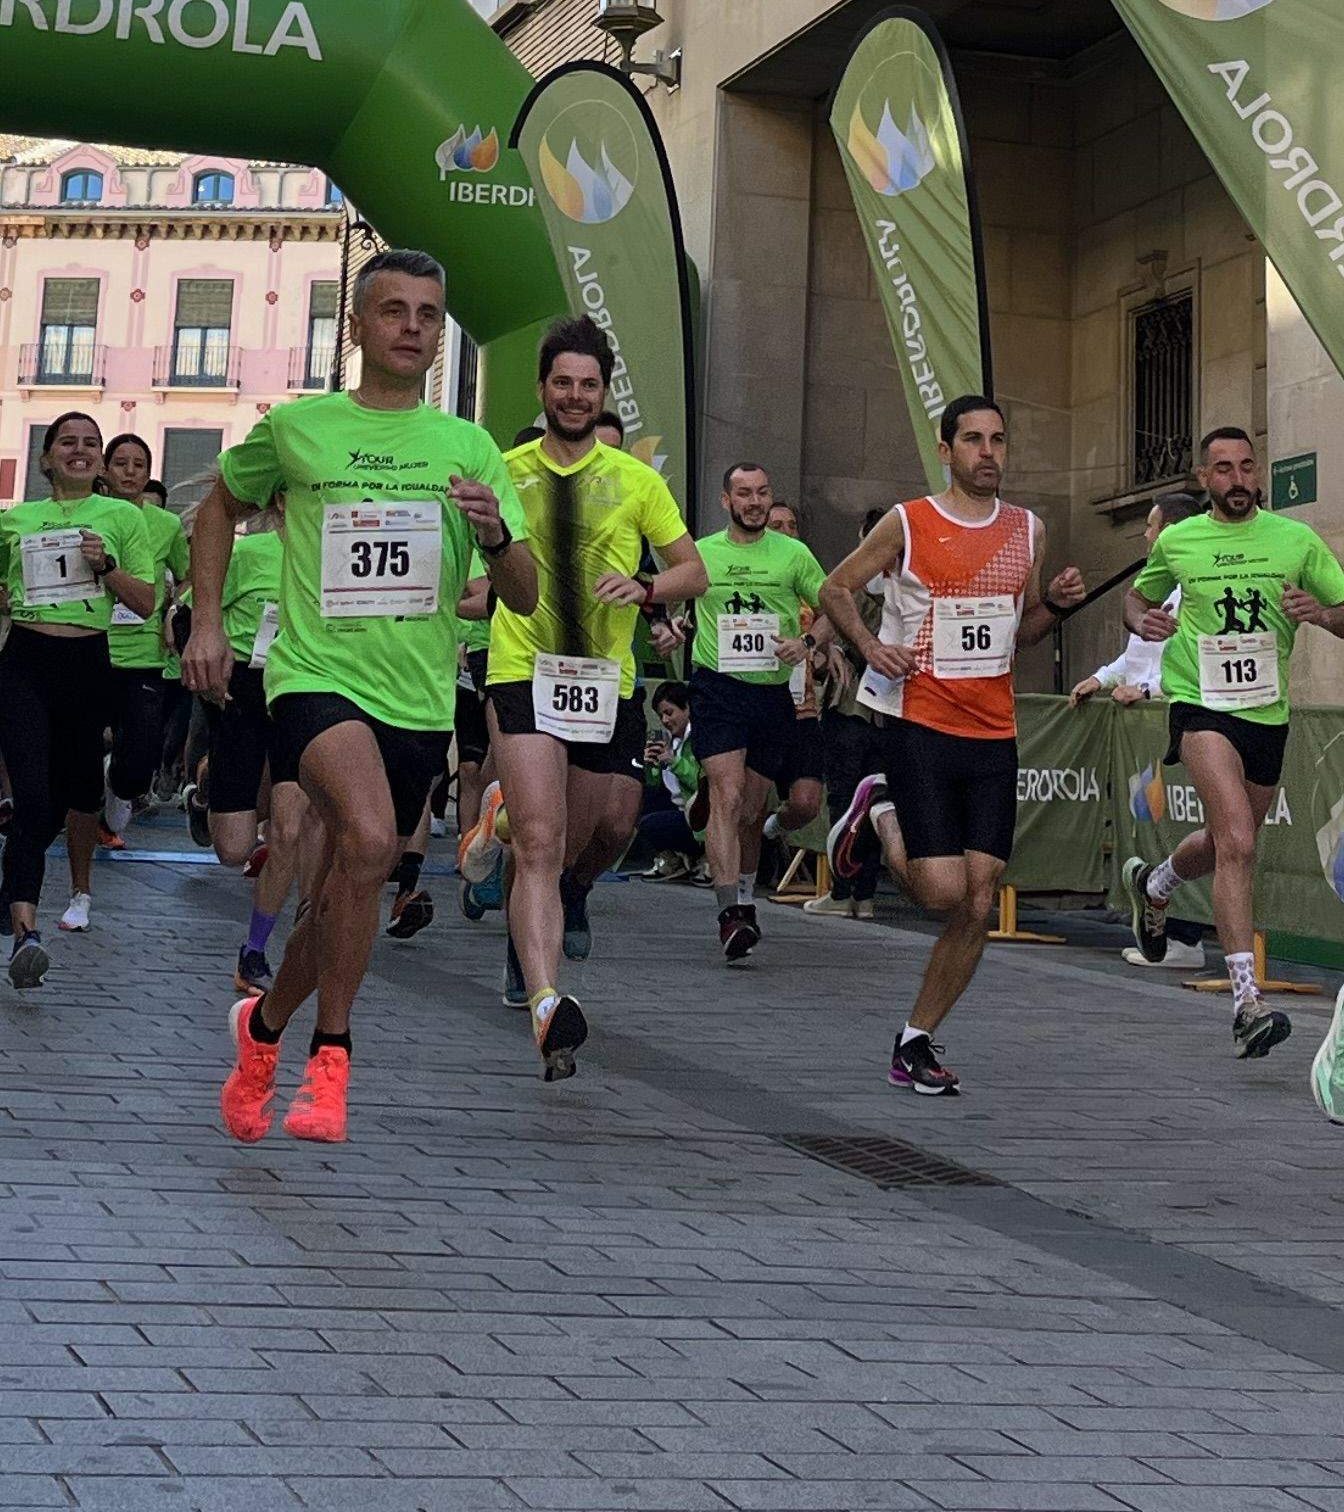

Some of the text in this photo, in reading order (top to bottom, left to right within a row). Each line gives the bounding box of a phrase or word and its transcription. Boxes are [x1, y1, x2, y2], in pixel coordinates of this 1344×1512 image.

[361, 481, 383, 491] POR
[385, 482, 399, 492] LA
[55, 554, 68, 578] 1
[350, 540, 410, 578] 375
[732, 633, 764, 653] 430
[961, 624, 991, 651] 56
[1221, 658, 1258, 683] 113
[552, 683, 599, 714] 583
